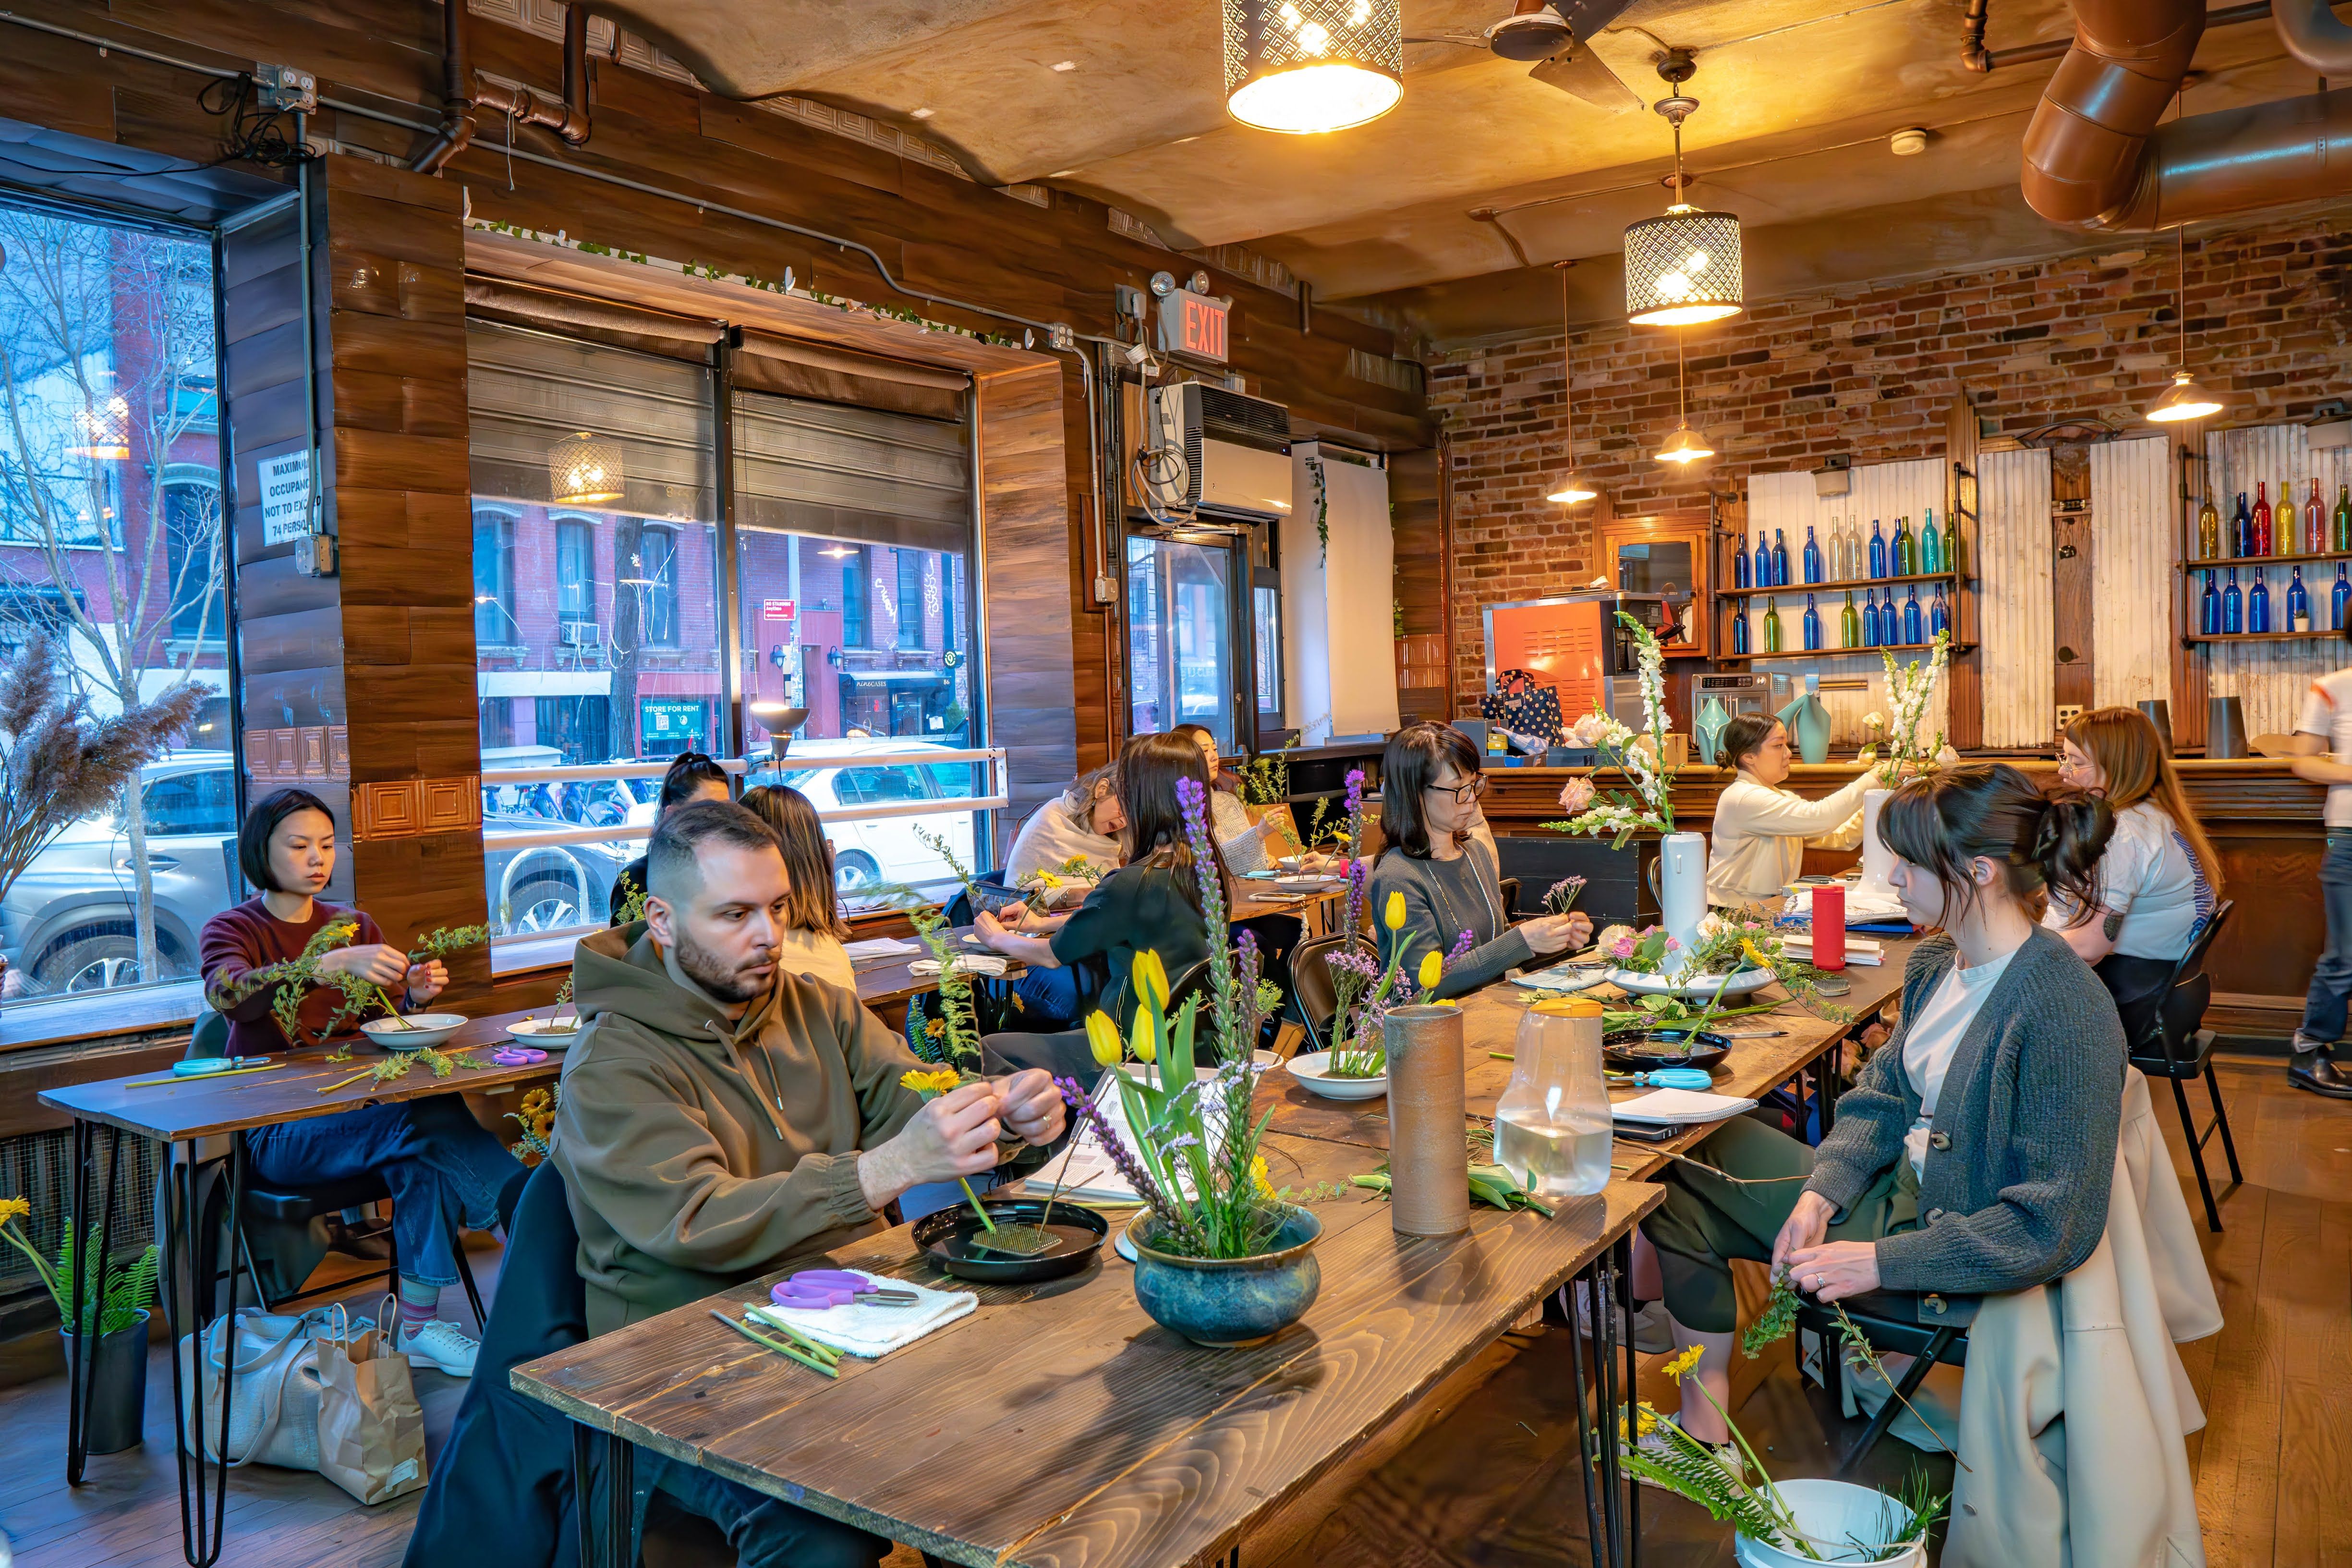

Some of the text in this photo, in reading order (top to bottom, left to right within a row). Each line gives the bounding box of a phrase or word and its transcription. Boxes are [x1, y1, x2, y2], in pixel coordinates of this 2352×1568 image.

[1186, 300, 1224, 356] EXIT
[270, 478, 309, 497] OCCUPANC
[265, 495, 321, 518] NOT TO EXCD
[272, 519, 306, 536] 74 PERSO
[947, 654, 953, 663] 9
